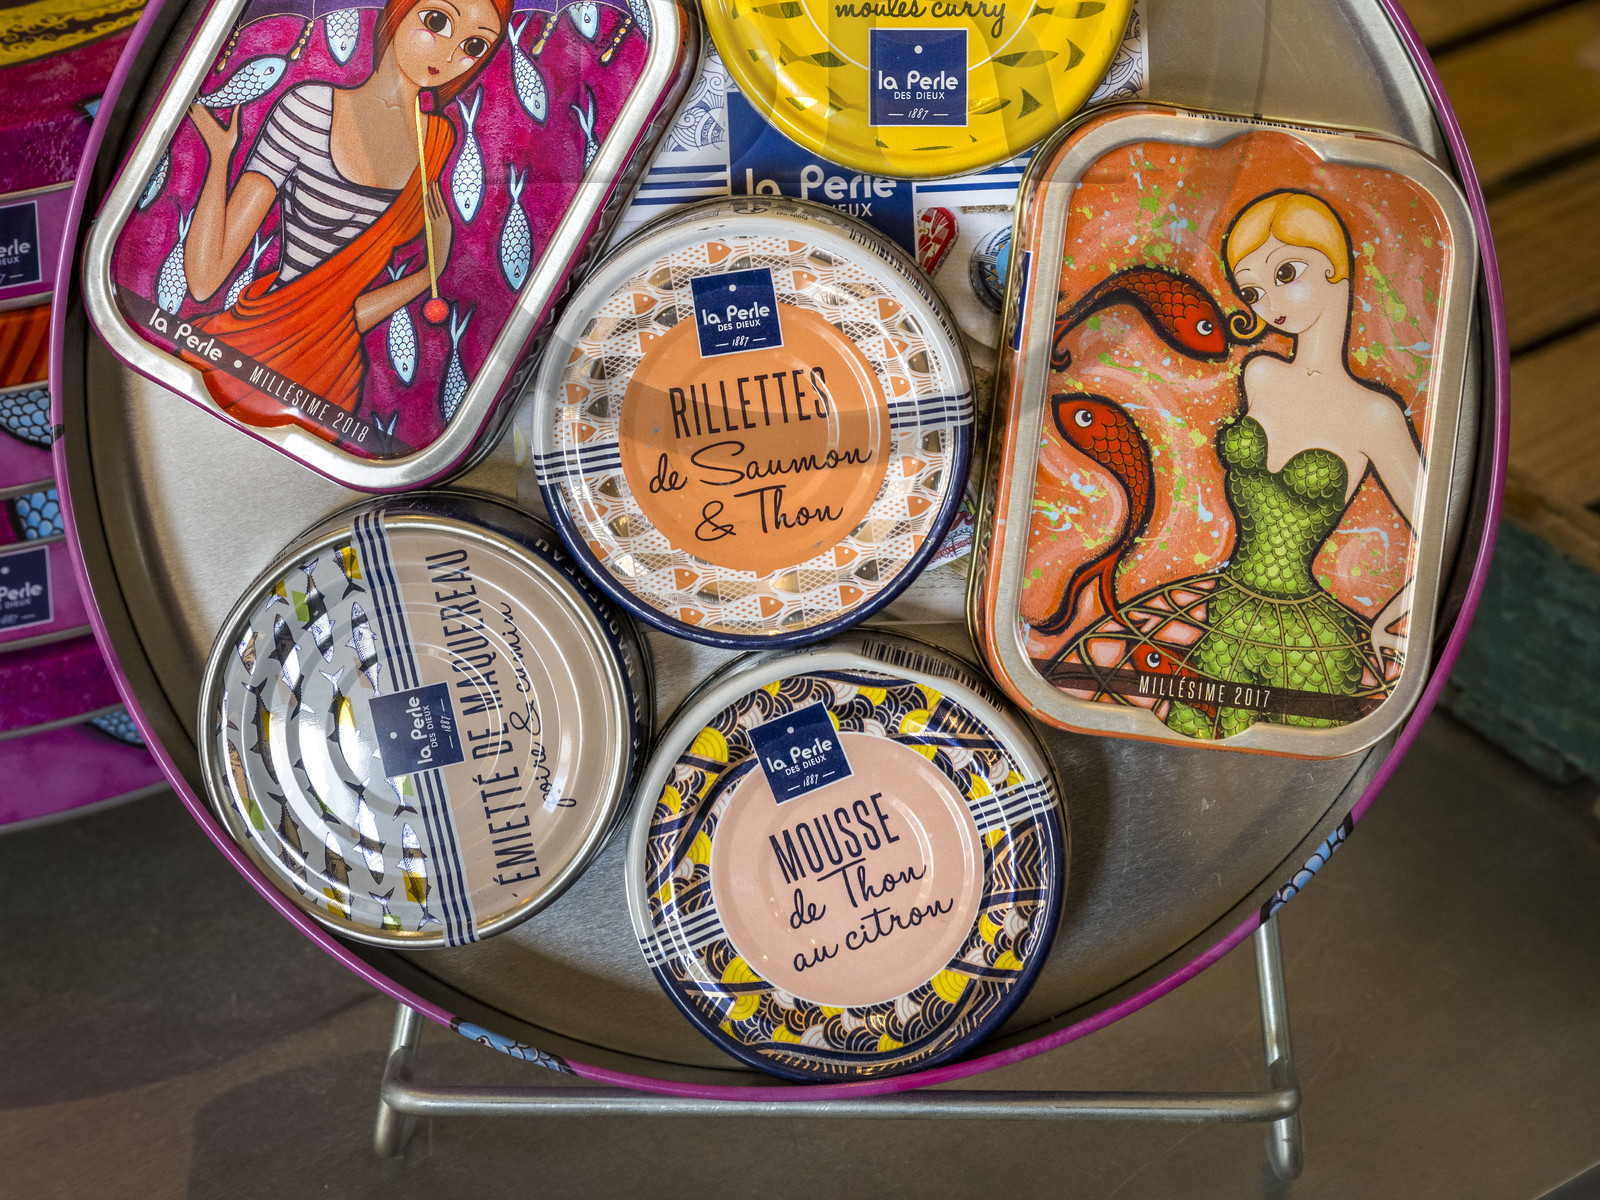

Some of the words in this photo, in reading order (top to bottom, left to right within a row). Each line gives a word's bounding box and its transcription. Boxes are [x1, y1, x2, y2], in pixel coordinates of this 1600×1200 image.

[931, 1, 1006, 39] curry
[878, 70, 899, 90] la
[907, 69, 959, 90] Perle
[894, 91, 911, 100] DES
[916, 91, 945, 100] DIEUX
[908, 107, 929, 120] 1887
[800, 164, 897, 200] Perle
[0, 239, 31, 257] erle
[702, 309, 721, 326] la
[726, 301, 770, 321] Perle
[717, 323, 733, 332] DES
[736, 319, 761, 329] DIEUX
[732, 335, 750, 347] 1887
[149, 308, 168, 334] la
[173, 322, 223, 362] Perle
[250, 365, 330, 421] MILLÉSIME
[332, 411, 370, 443] 2018
[669, 366, 830, 439] RILLETTES
[649, 453, 688, 494] de
[690, 440, 873, 486] Saumon
[694, 500, 737, 542] &
[733, 484, 844, 534] Thon
[425, 549, 502, 717] MAQUEREAU
[501, 602, 531, 694] cumin
[1139, 675, 1226, 703] MILLÉSIME
[1234, 686, 1271, 708] 2017
[405, 696, 427, 741] Perle
[422, 705, 436, 732] DIEUX
[440, 714, 452, 732] 1887
[509, 700, 542, 736] &
[417, 745, 433, 765] la
[430, 734, 439, 748] DES
[467, 722, 514, 760] DE
[766, 757, 788, 773] la
[789, 737, 833, 764] Perle
[785, 765, 800, 776] DES
[802, 754, 827, 769] DIEUX
[803, 774, 819, 787] 1887
[472, 766, 541, 886] ÉMIETTÉ
[769, 792, 900, 885] MOUSSE
[790, 888, 826, 929] de
[817, 857, 927, 908] Thon
[793, 944, 839, 972] au
[845, 898, 954, 951] citron
